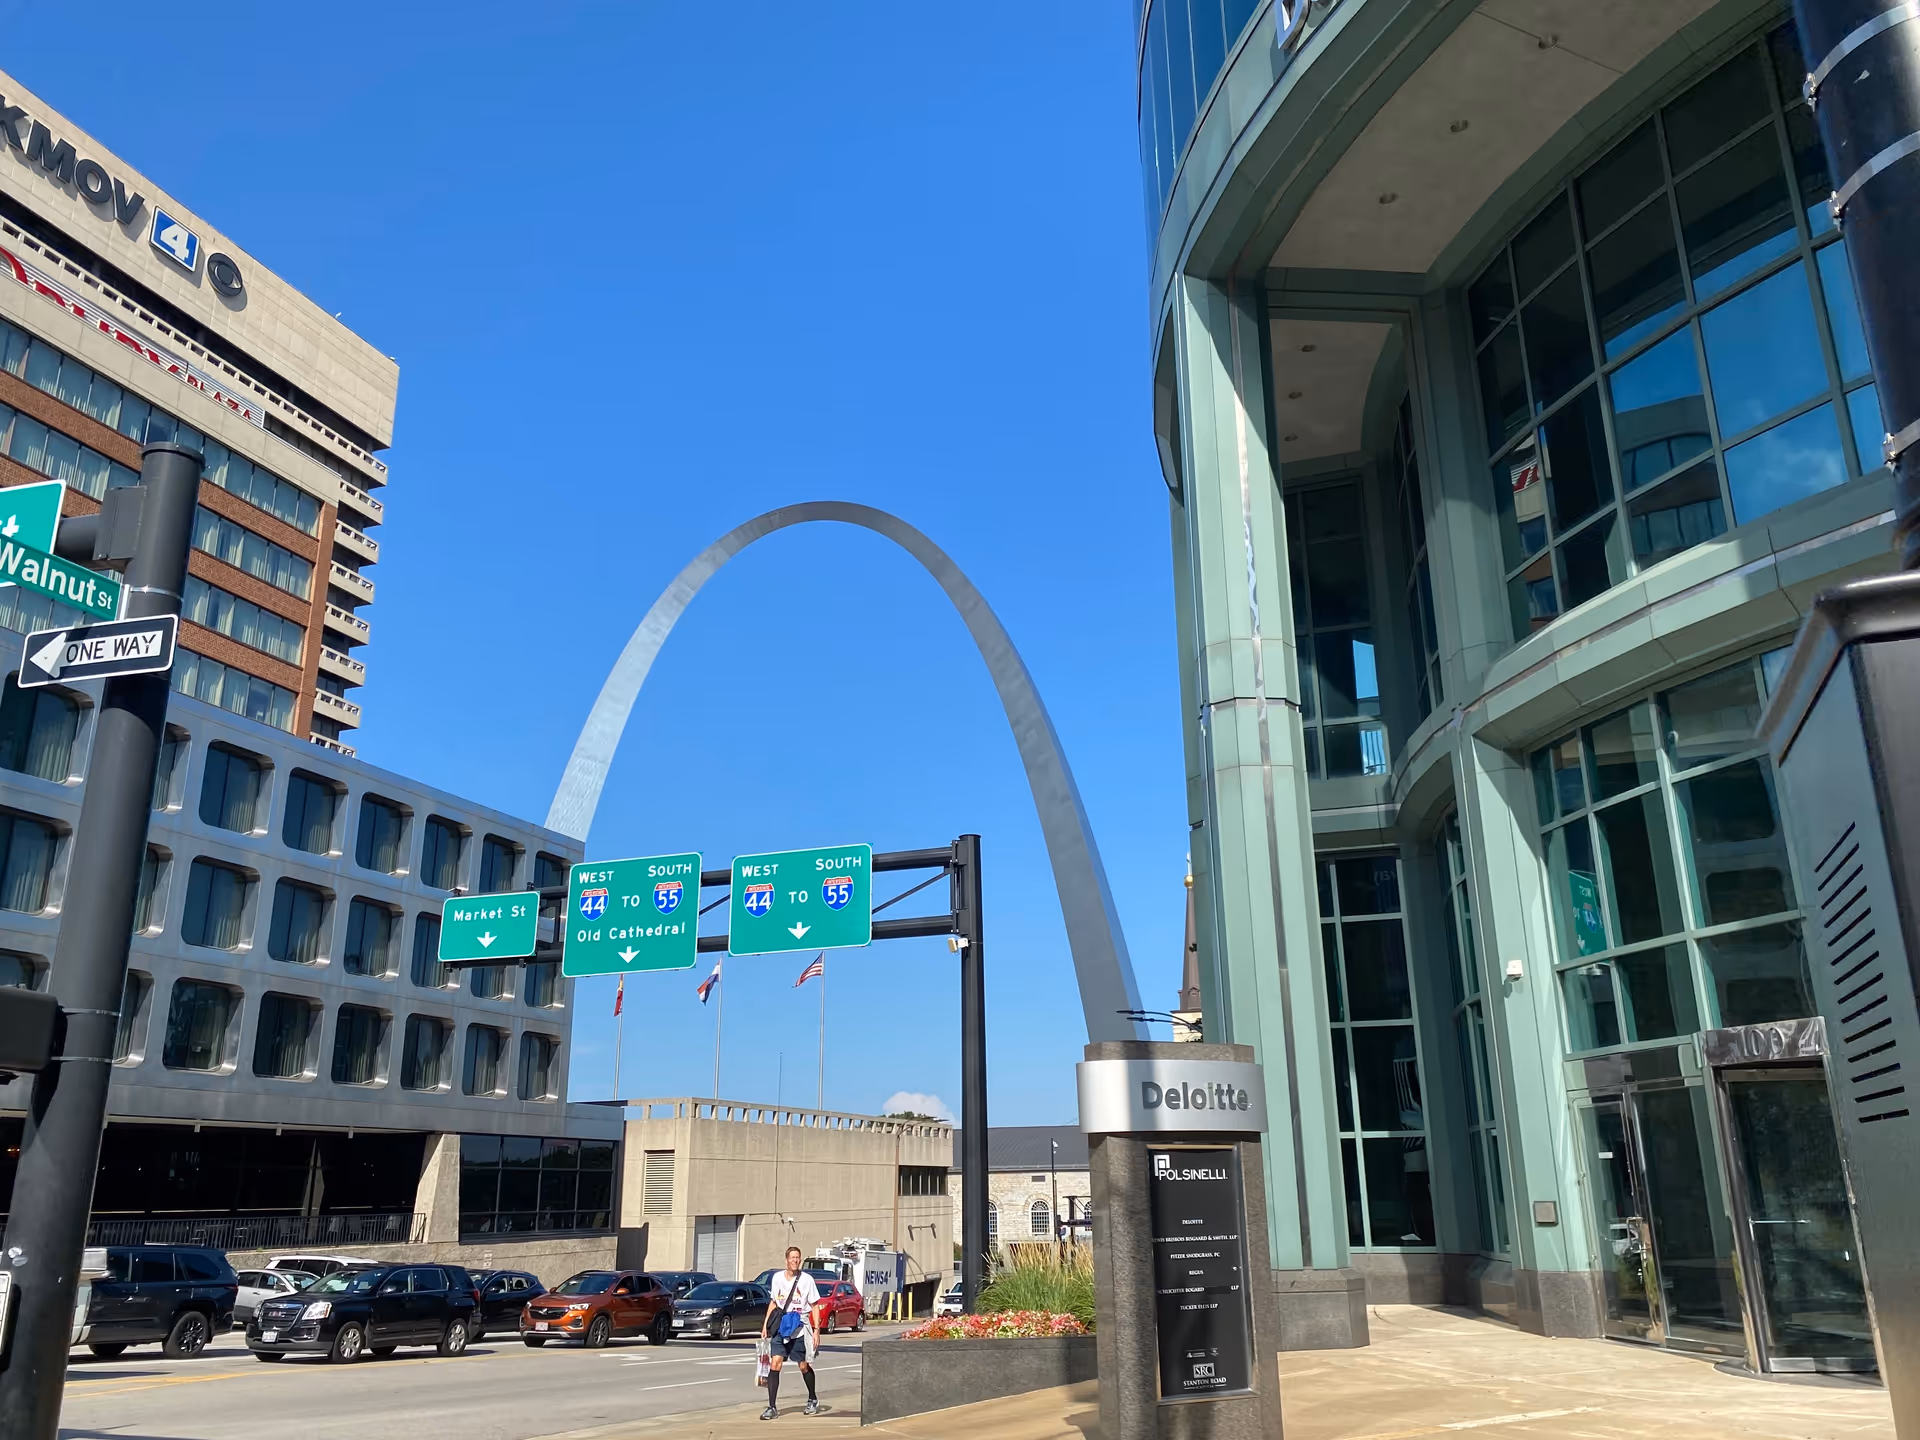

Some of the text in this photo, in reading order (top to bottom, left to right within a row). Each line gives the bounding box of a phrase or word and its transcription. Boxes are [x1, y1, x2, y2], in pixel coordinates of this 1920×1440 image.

[0, 94, 190, 262] KMOV 4
[0, 538, 113, 610] Walnut St
[66, 634, 157, 663] ONE WAY
[579, 863, 692, 884] WEST SOUTH
[742, 856, 862, 877] WEST SOUTH
[581, 890, 679, 914] 44 TO 55
[745, 885, 849, 911] 44 TO 55
[453, 905, 527, 922] Market St
[577, 921, 686, 942] Old Cathedral
[1158, 1168, 1226, 1181] POLSINELLI
